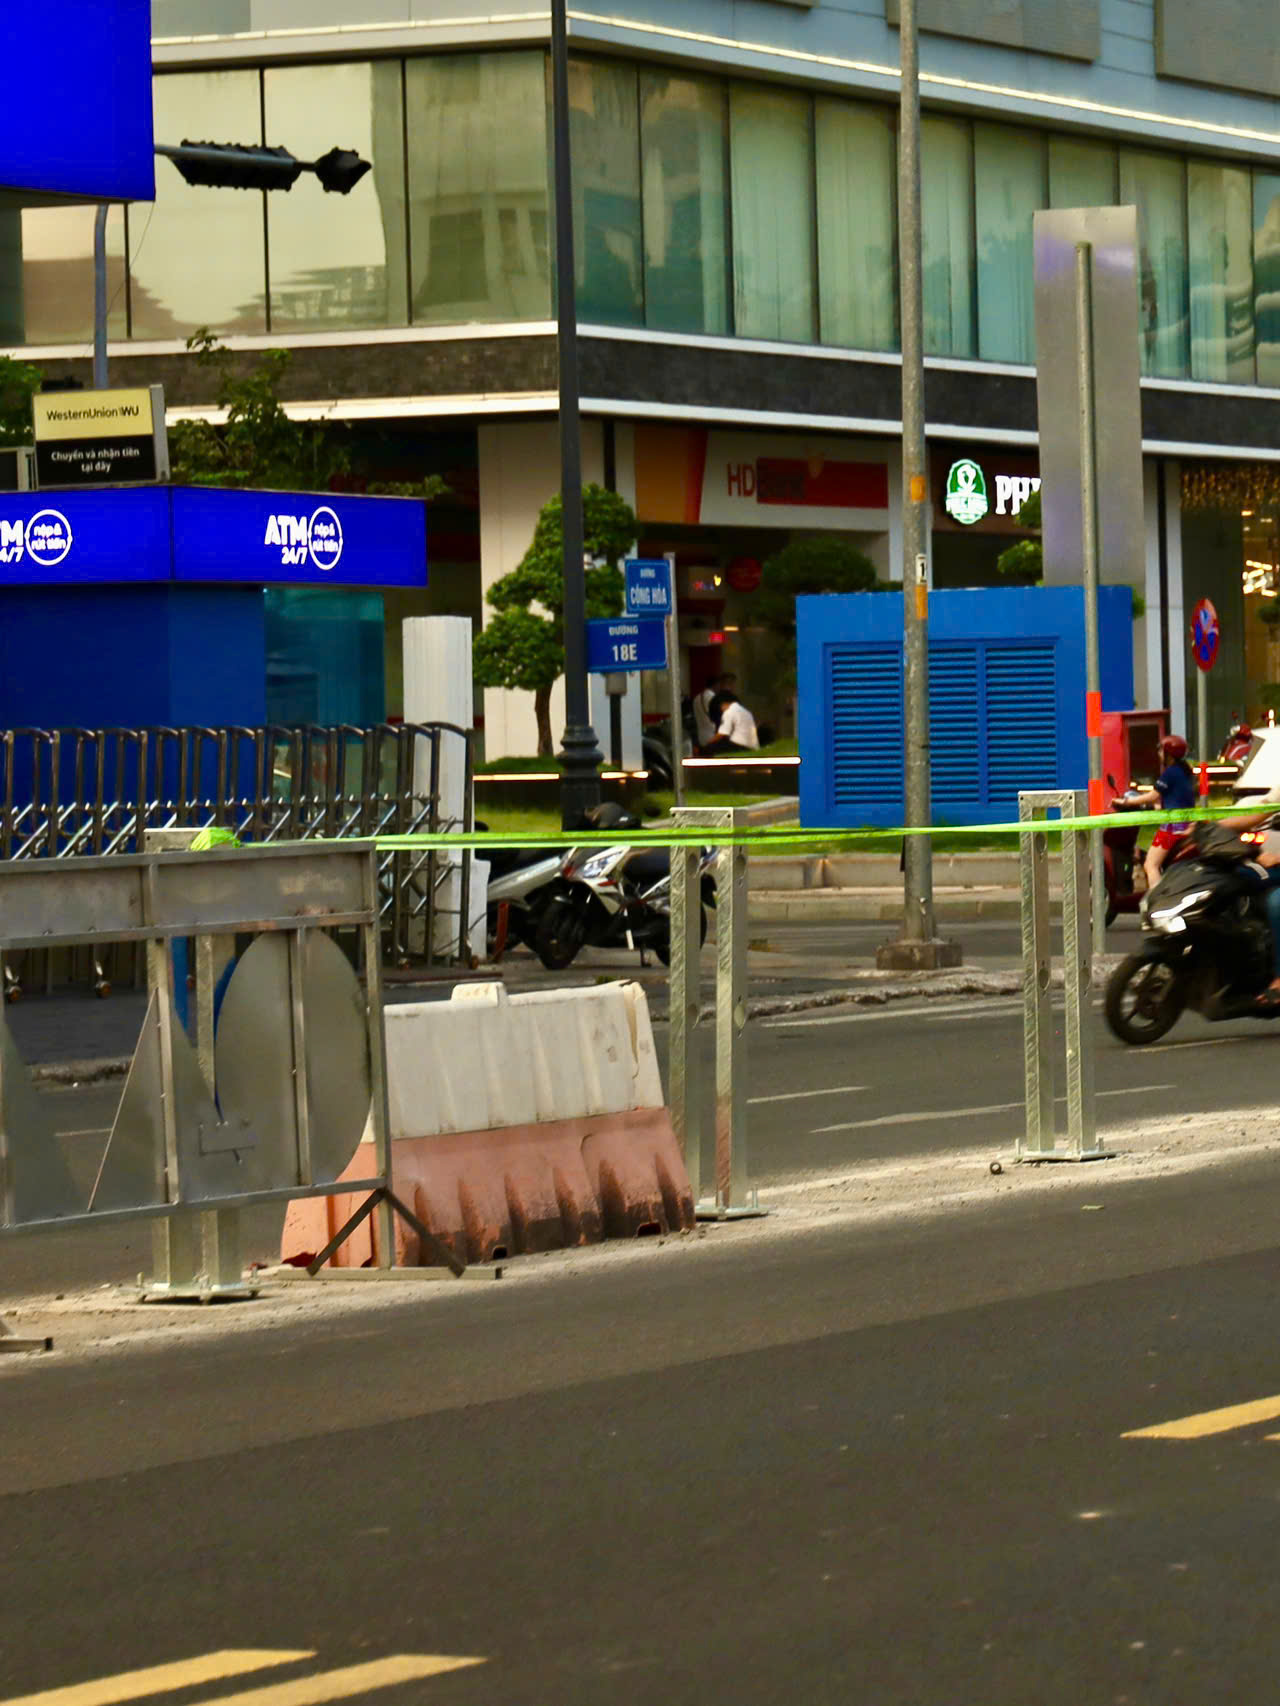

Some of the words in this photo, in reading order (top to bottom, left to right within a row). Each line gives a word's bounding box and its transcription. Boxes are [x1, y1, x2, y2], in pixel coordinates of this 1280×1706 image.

[264, 514, 307, 546] ATM
[281, 546, 308, 565] 24/7
[612, 643, 638, 663] 18E
